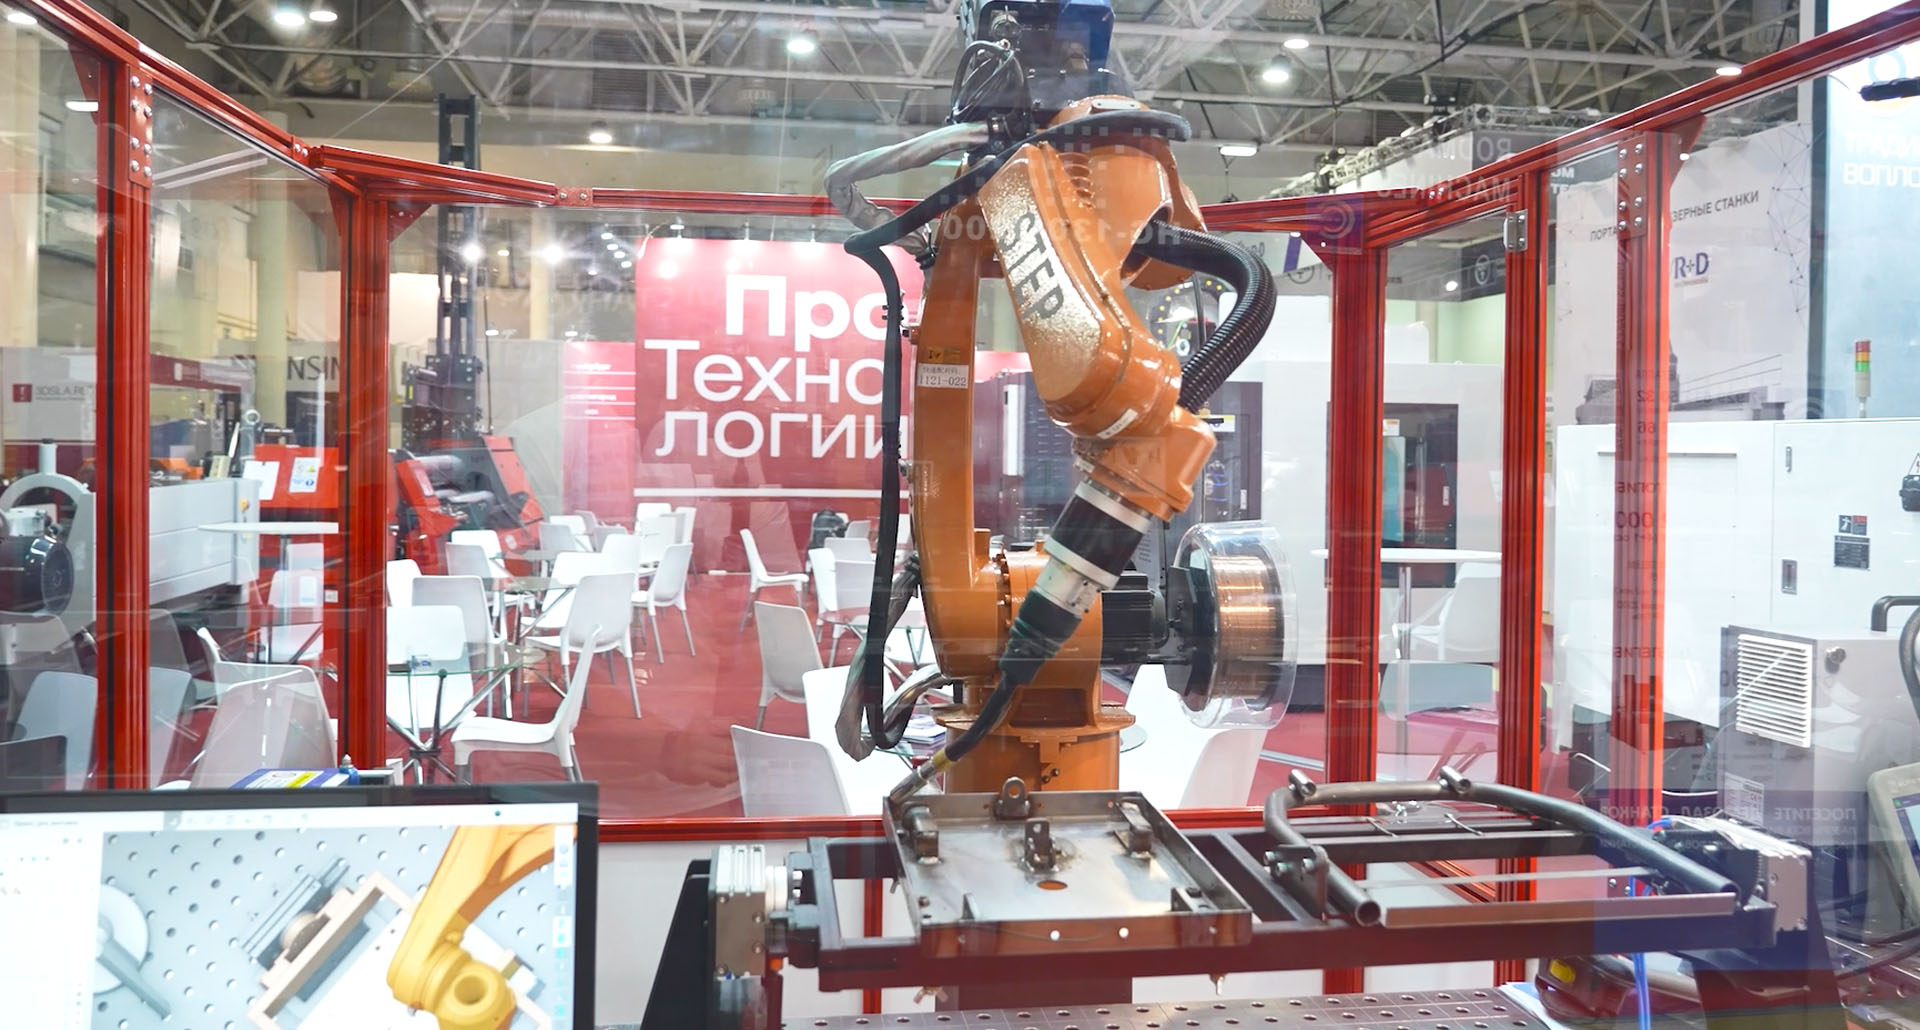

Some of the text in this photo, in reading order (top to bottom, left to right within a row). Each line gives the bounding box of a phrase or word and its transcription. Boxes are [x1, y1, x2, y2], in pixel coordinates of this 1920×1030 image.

[1672, 201, 1712, 222] ЗЕРНЫЕ
[1714, 189, 1760, 213] СТАНКИ
[997, 212, 1065, 320] STEP
[726, 274, 908, 352] Про
[644, 339, 885, 405] Техно
[920, 375, 967, 387] 1121-022
[655, 410, 909, 460] логии
